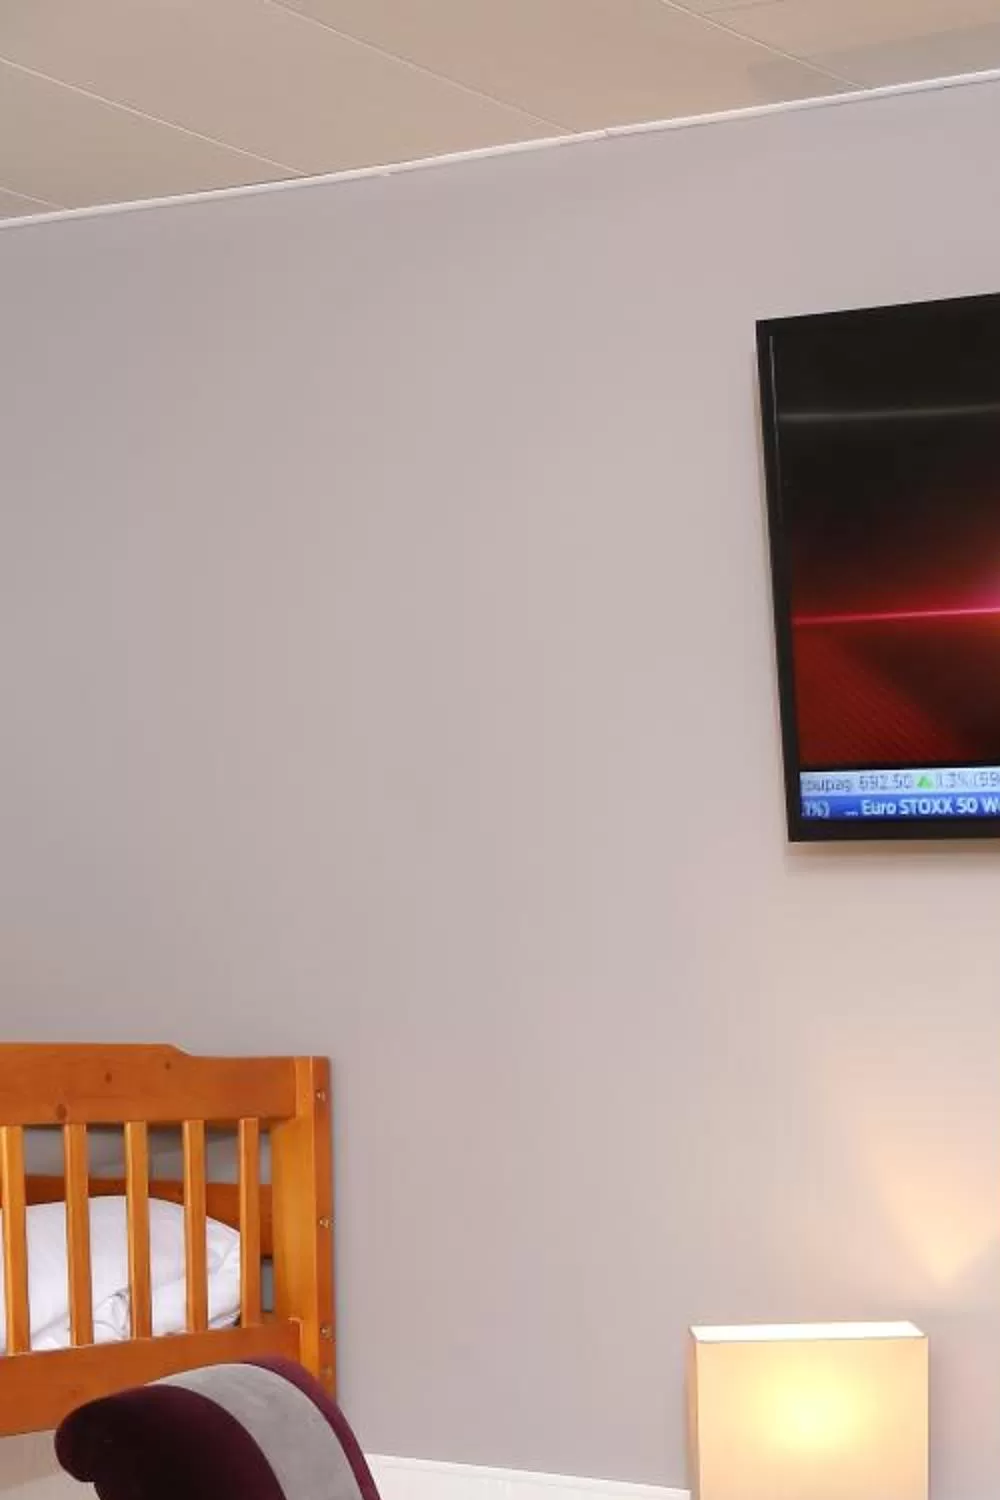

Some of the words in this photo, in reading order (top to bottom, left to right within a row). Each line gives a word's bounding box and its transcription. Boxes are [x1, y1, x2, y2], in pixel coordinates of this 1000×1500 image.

[861, 799, 897, 816] Euro
[899, 798, 955, 815] STOXX
[956, 797, 979, 814] 50
